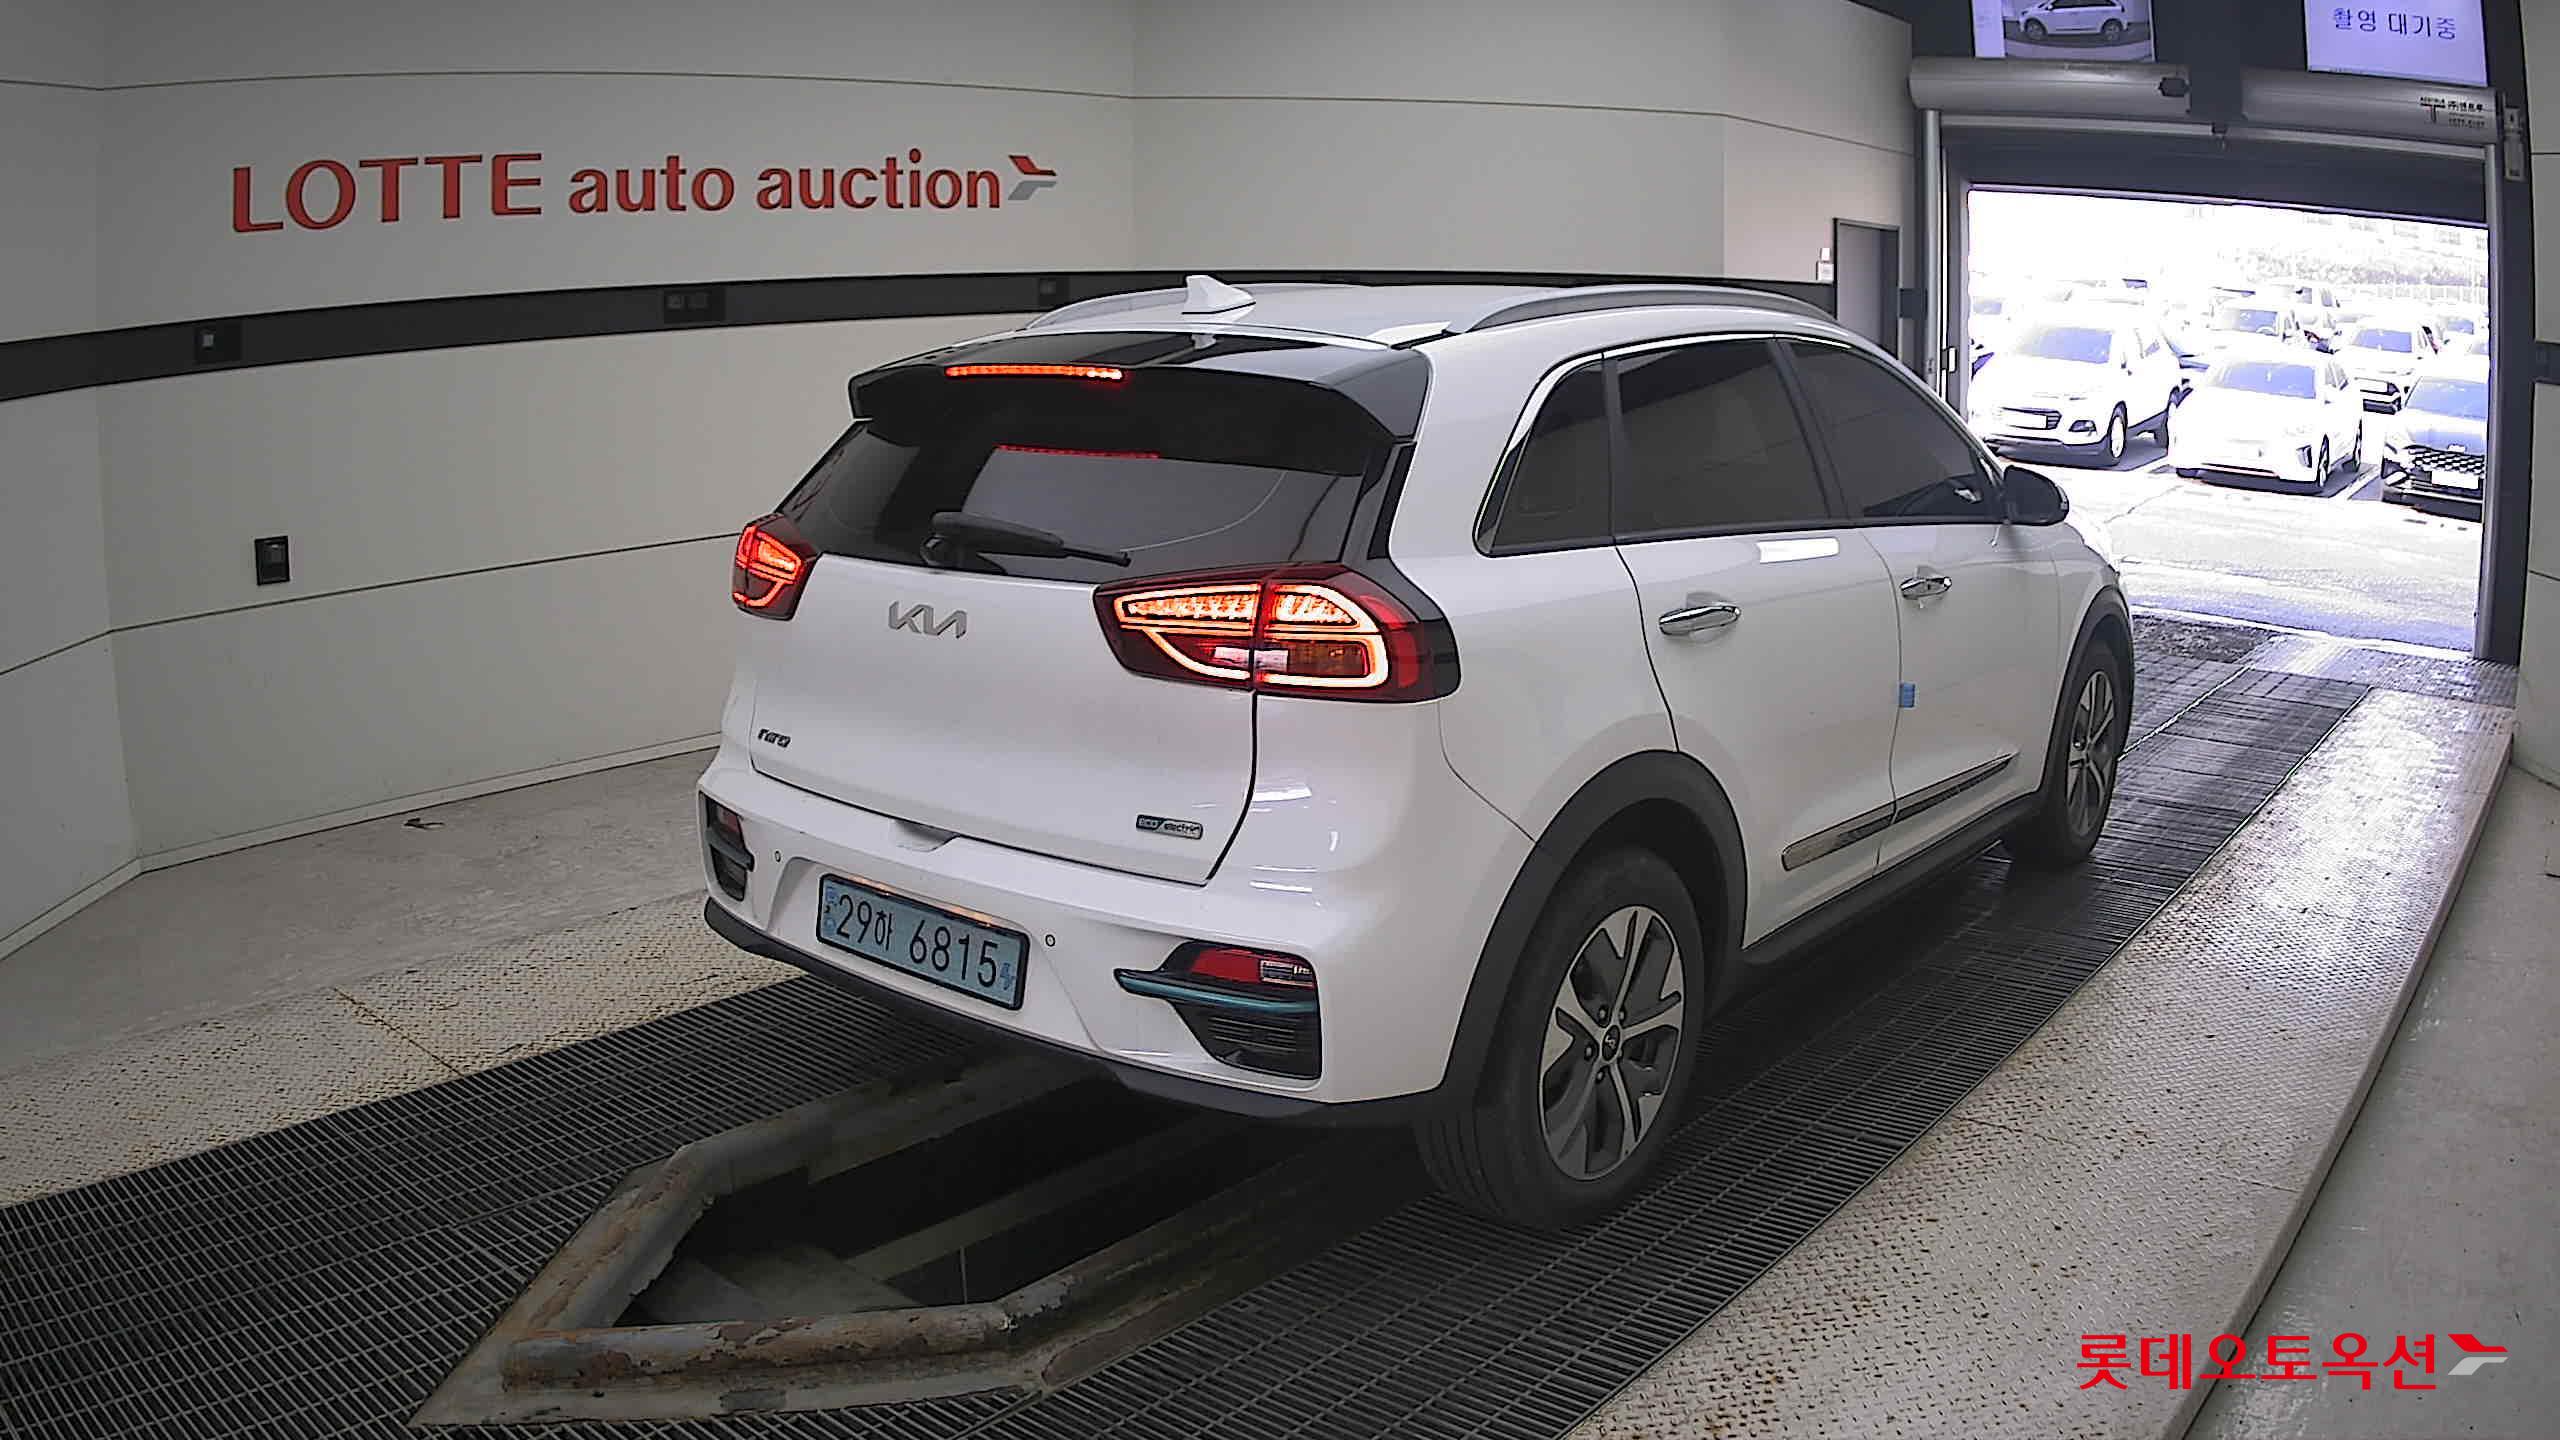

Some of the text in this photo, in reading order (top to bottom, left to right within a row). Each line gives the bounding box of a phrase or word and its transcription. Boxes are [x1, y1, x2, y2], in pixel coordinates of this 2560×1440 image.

[2388, 13, 2456, 40] 대기중
[232, 148, 1002, 233] LOTTE auto auction
[889, 601, 967, 638] KIA
[836, 894, 999, 988] 29하 6815
